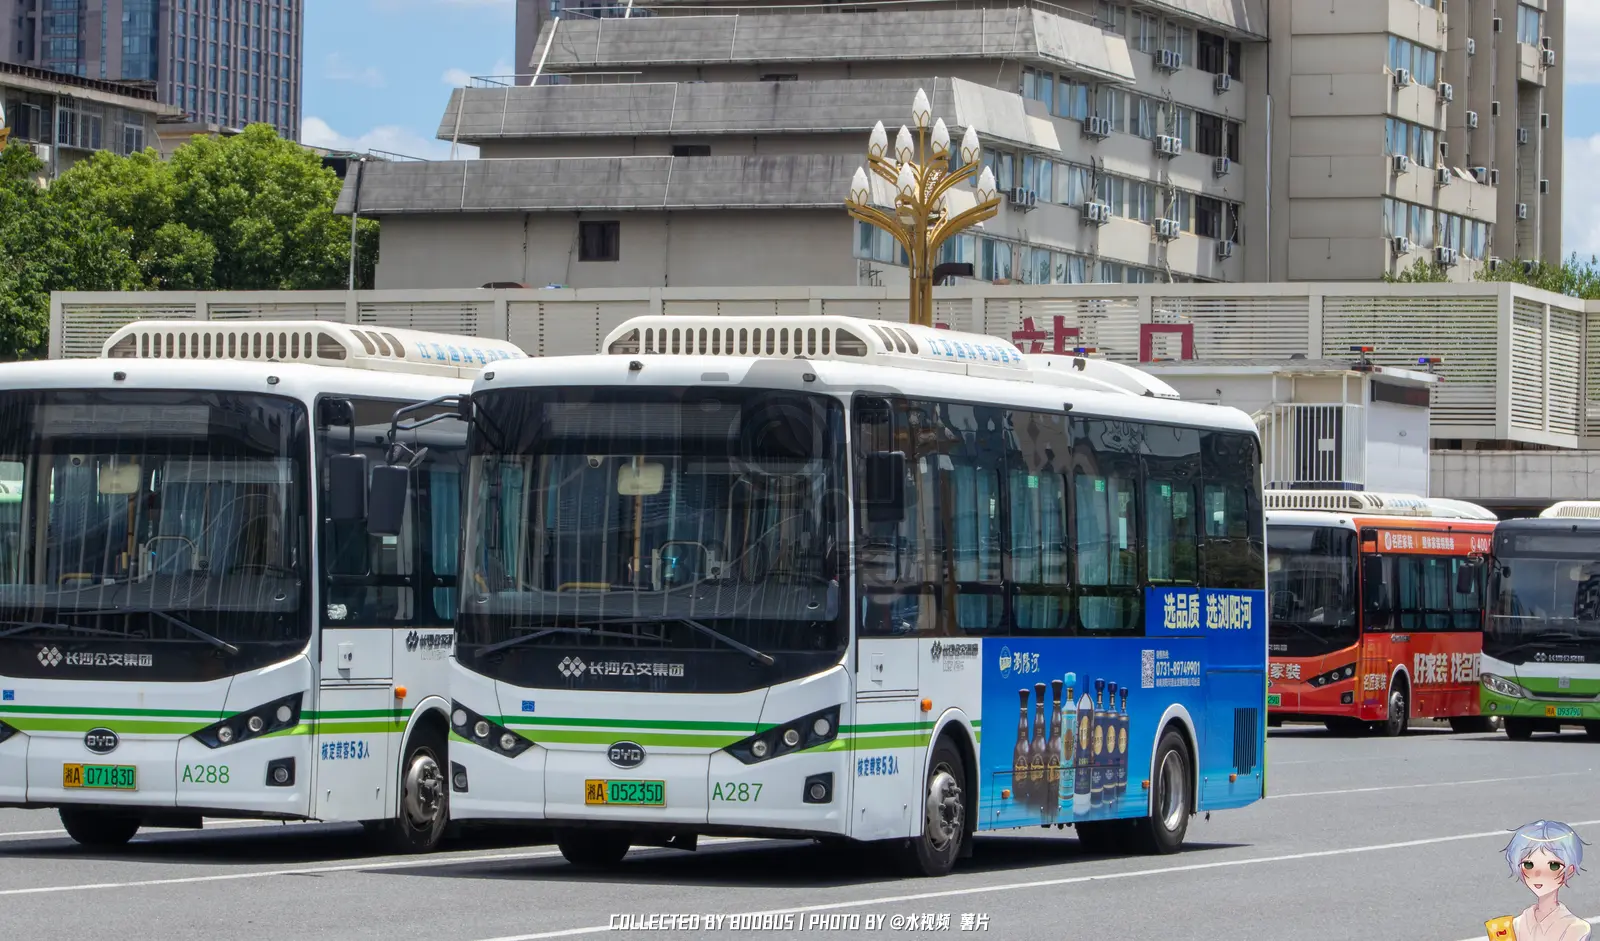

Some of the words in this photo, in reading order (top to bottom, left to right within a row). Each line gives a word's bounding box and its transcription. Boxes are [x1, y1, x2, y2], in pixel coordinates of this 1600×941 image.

[1164, 592, 1200, 629] 选品质
[1206, 593, 1252, 629] 选浏阳河
[65, 652, 153, 667] 长沙公交集团
[1413, 652, 1449, 685] 好家装
[589, 661, 684, 677] 长沙公交集团
[1268, 662, 1301, 680] 家装
[1363, 673, 1387, 691] 名匠家装
[87, 735, 115, 747] BYD
[611, 748, 641, 761] BYD
[182, 764, 230, 783] A288
[712, 782, 763, 801] A287
